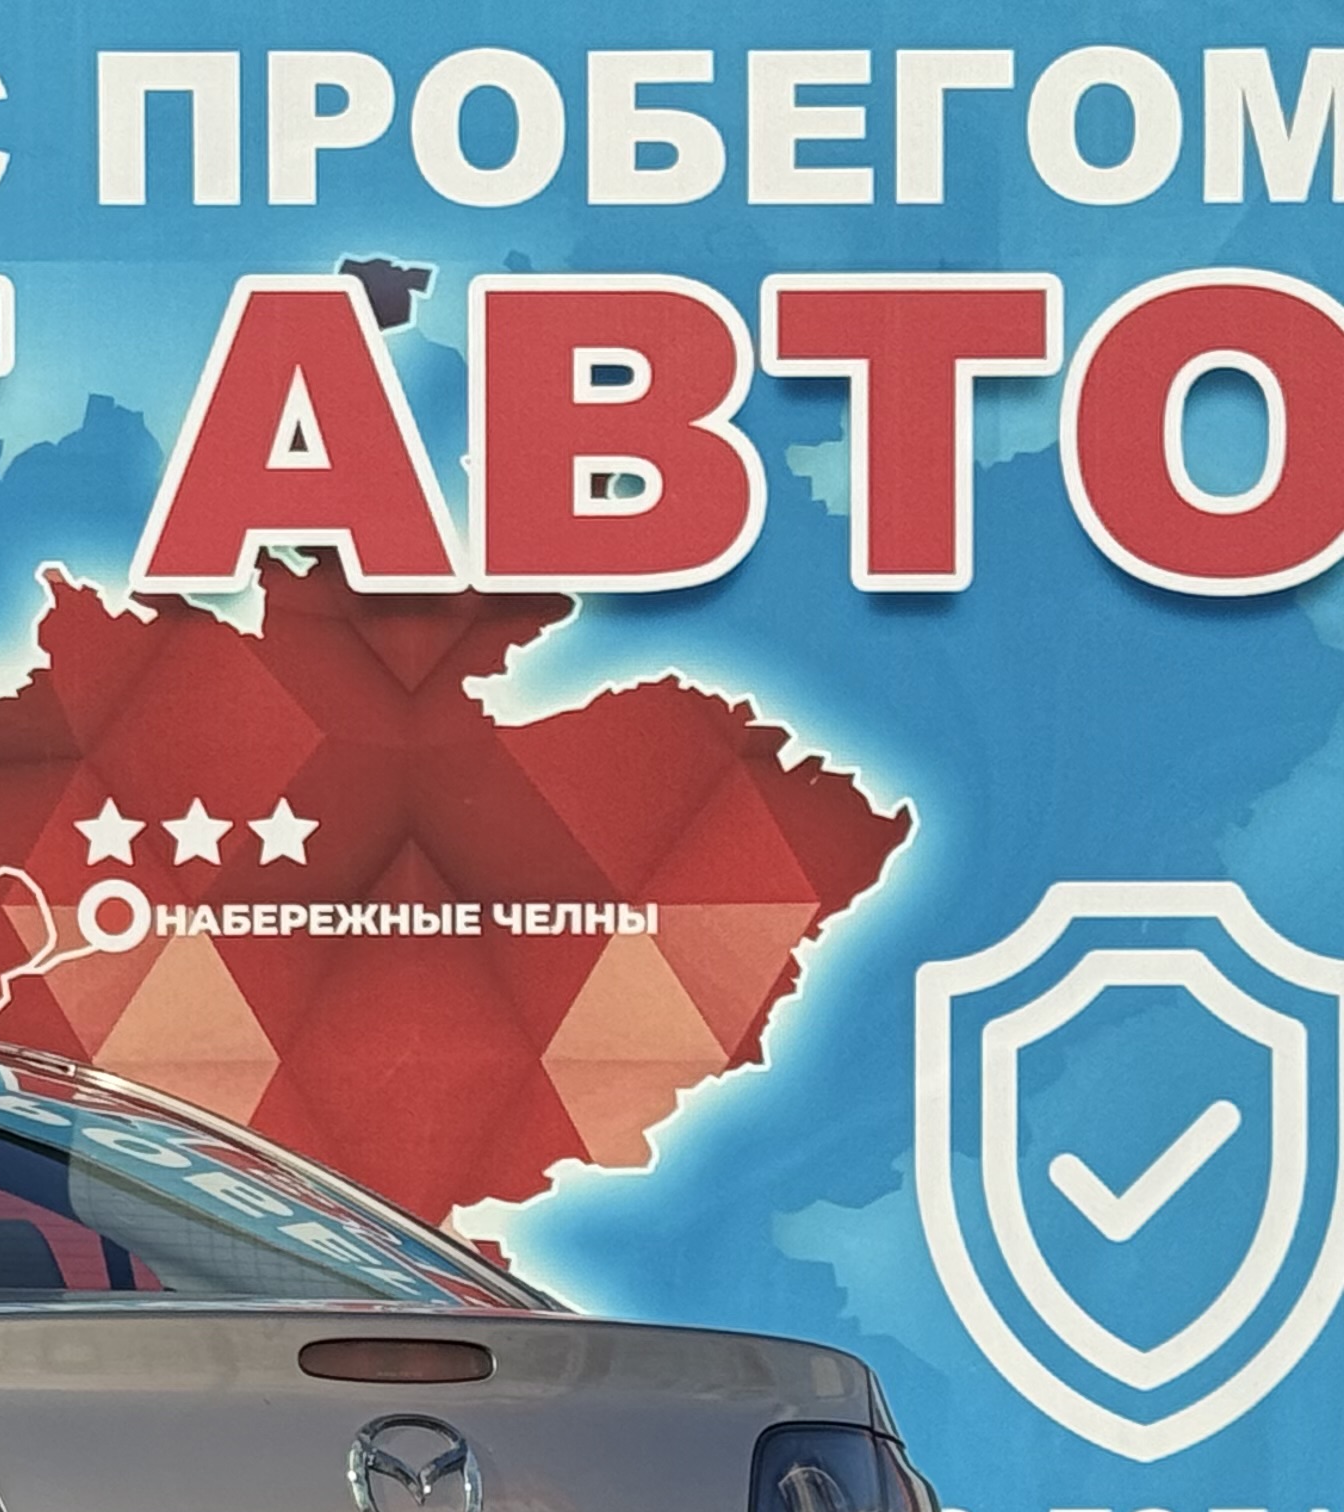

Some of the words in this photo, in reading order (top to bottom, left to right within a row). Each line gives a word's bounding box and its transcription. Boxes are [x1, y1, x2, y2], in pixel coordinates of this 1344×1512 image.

[96, 45, 1344, 207] ПРОБЕГОМ
[130, 268, 1344, 598] АВТО
[156, 902, 482, 937] НАБЕРЕЖНЫЕ
[495, 903, 658, 936] ЧЕЛНЫ
